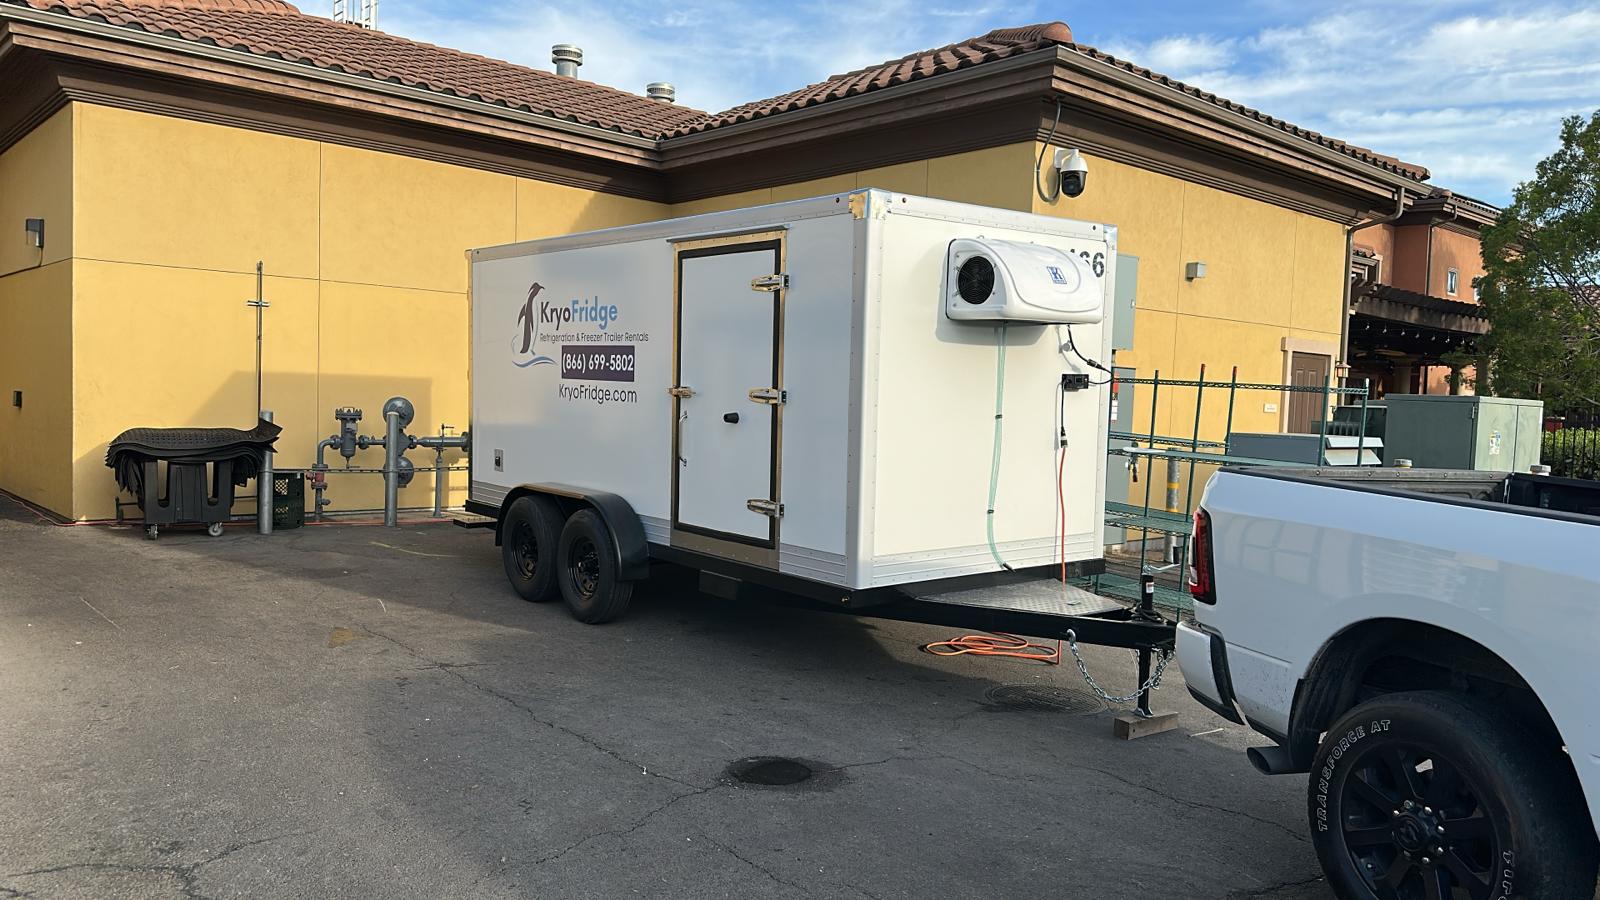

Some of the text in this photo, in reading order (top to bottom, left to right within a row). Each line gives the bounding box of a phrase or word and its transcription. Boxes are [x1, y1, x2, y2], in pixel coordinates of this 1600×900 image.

[540, 296, 618, 330] KryoFridge
[540, 332, 649, 344] Refrigeration & Freezer Trailer Rentals
[562, 353, 634, 373] (866) 699-5802
[558, 384, 638, 404] KryoFridge.com
[1317, 719, 1391, 832] TRANSFORCE AT
